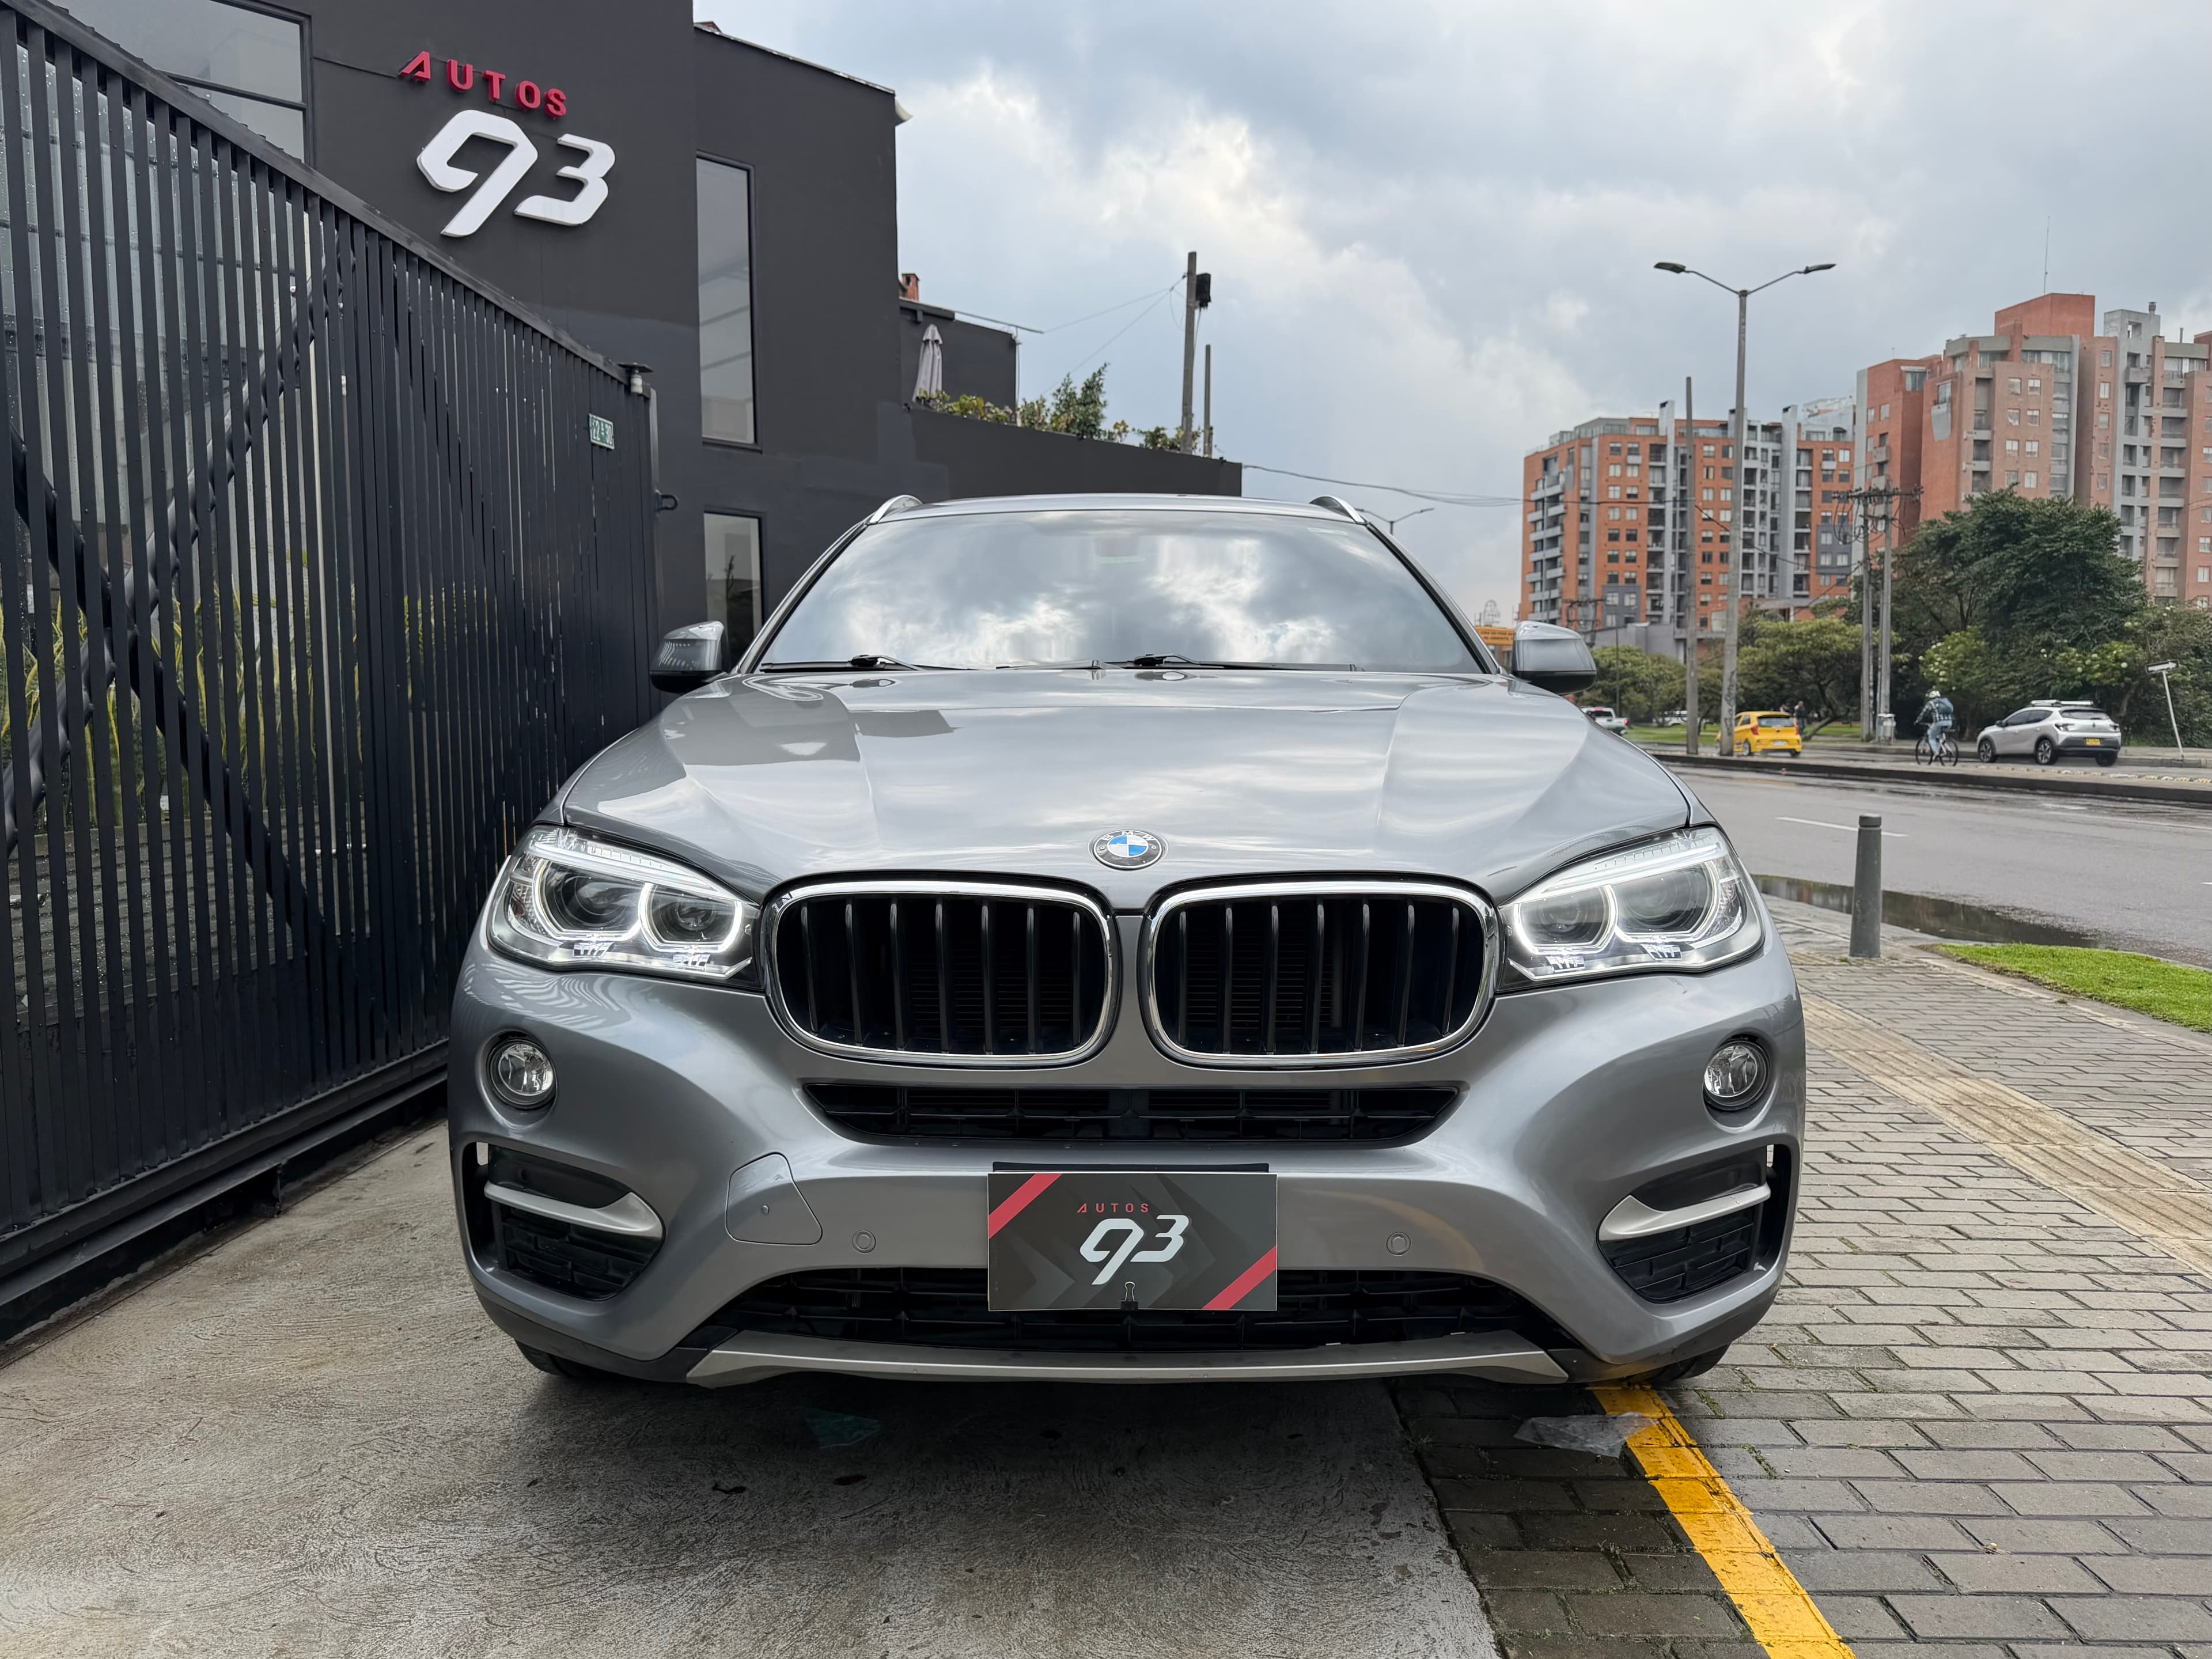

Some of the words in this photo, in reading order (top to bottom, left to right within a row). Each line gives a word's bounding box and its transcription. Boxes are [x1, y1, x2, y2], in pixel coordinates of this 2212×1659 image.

[398, 51, 567, 118] AUTOS
[416, 109, 616, 237] 93
[1101, 831, 1157, 841] BMW
[1077, 1203, 1149, 1213] AUTOS
[1080, 1214, 1190, 1285] 93
